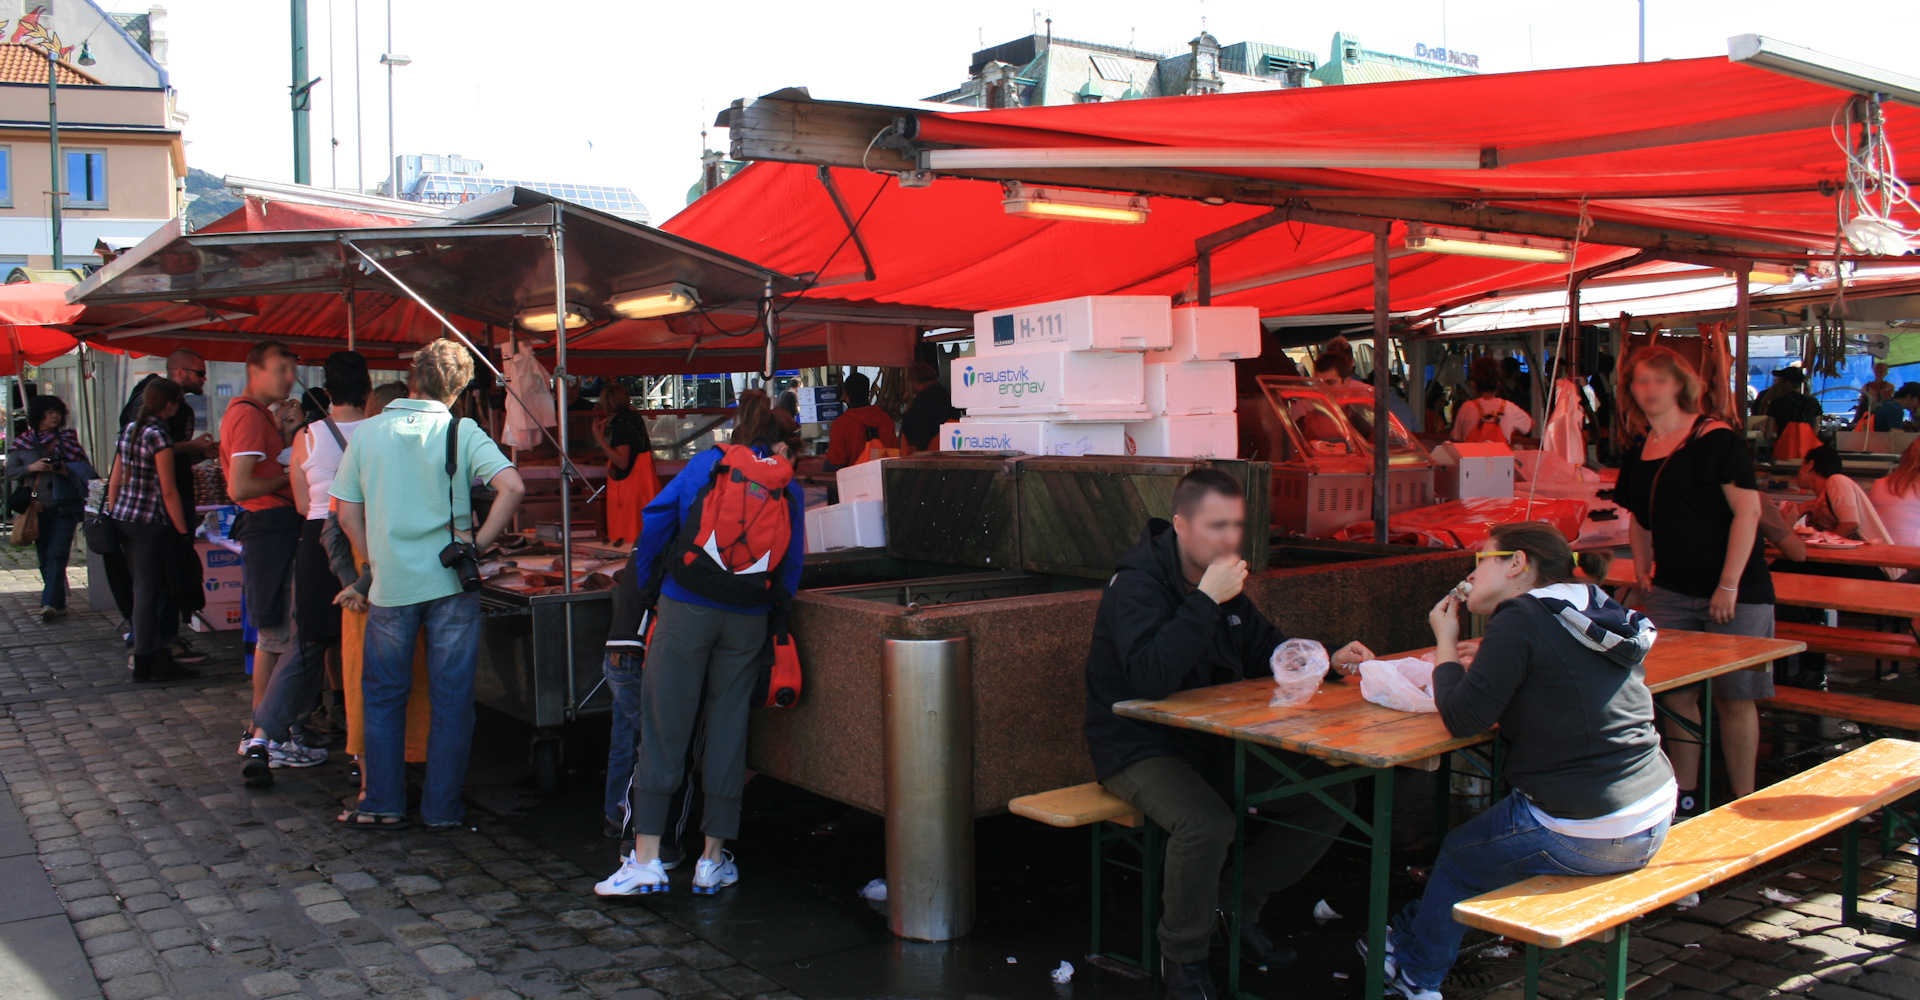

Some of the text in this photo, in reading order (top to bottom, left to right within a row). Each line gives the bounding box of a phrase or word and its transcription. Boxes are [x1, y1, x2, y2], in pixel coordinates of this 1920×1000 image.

[1416, 42, 1479, 68] DnB NOR
[1020, 313, 1062, 338] H-111
[977, 365, 1029, 384] naustvik
[999, 376, 1045, 397] enghav
[964, 433, 1011, 450] naustvik
